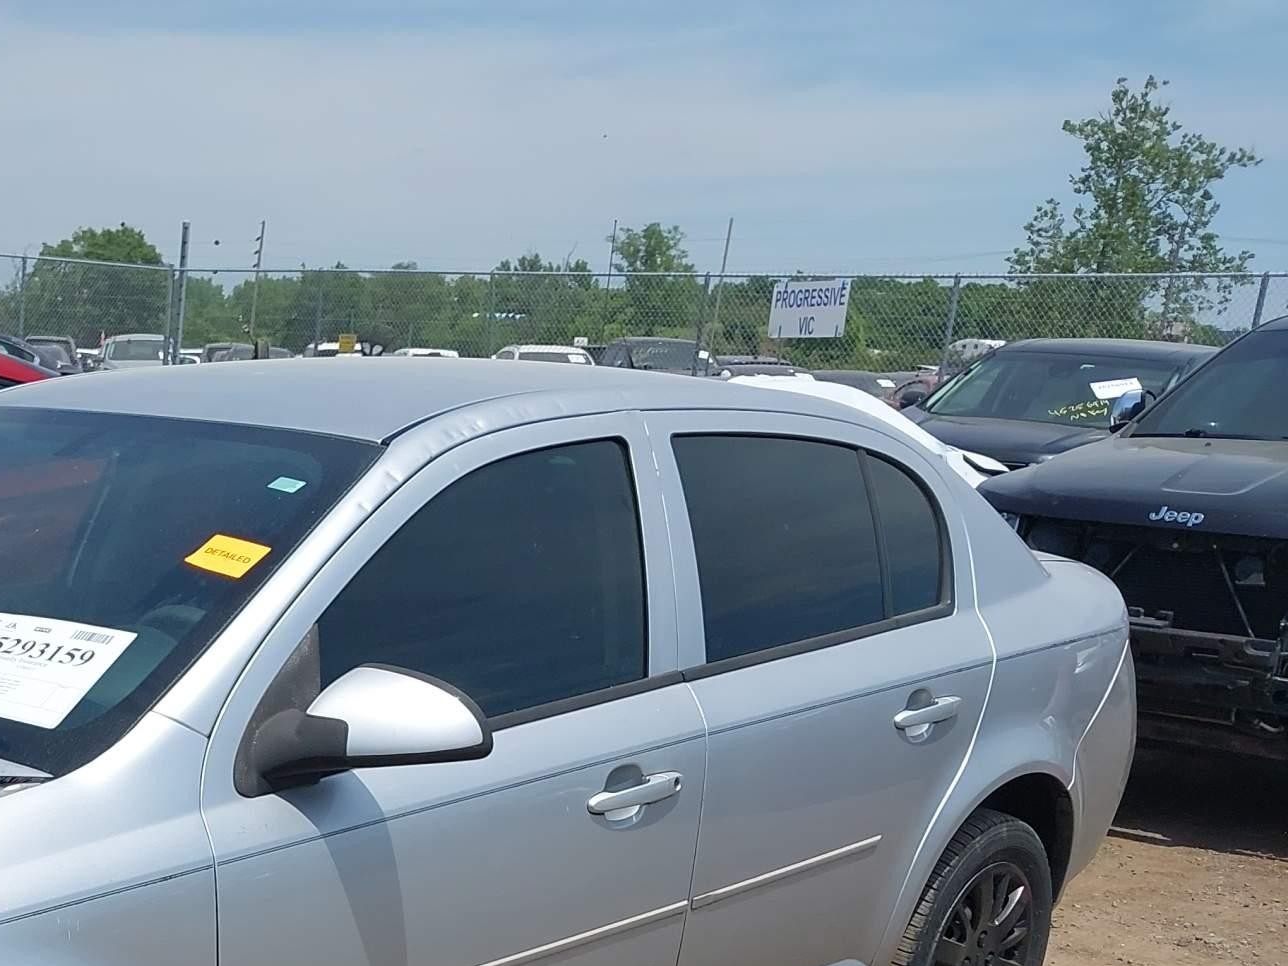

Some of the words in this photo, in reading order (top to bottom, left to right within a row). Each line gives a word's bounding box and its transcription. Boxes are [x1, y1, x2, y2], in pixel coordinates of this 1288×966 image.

[775, 287, 846, 309] PROGRESSIVE
[799, 316, 815, 335] VIC
[1149, 506, 1205, 527] Jeep
[204, 547, 251, 564] DETAILED
